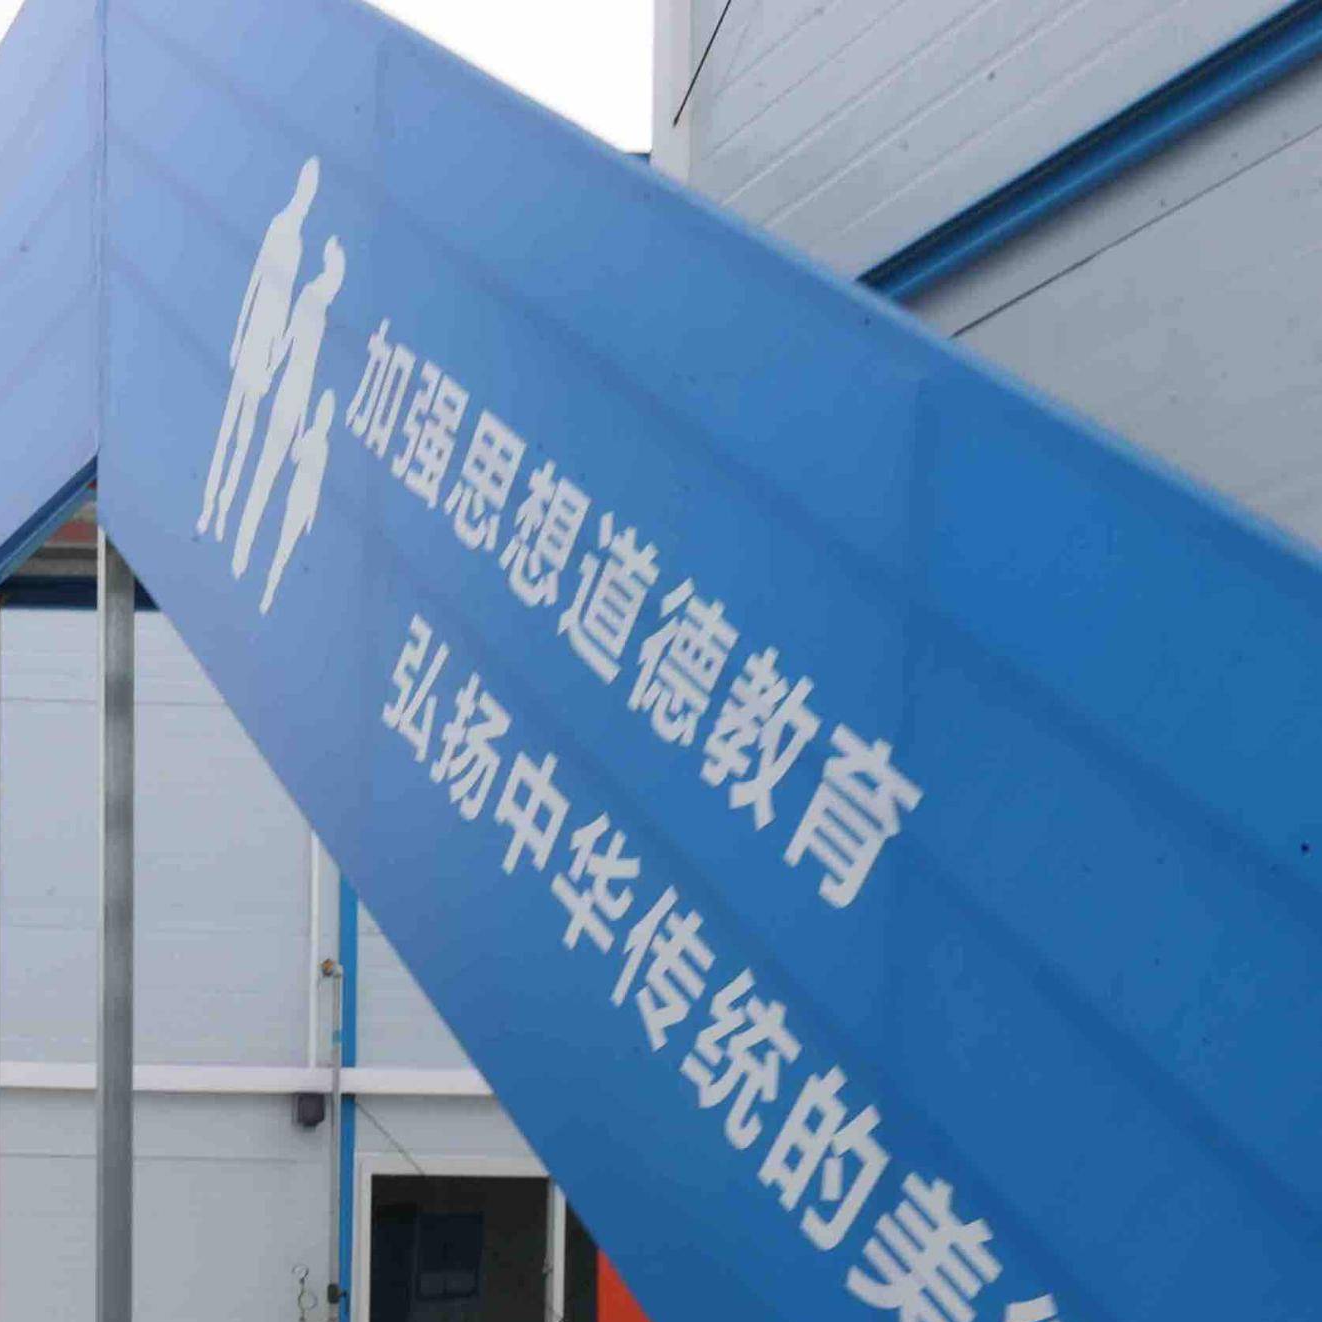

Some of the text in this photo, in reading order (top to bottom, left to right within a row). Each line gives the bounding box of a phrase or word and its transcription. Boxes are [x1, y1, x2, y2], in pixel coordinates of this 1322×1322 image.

[344, 319, 925, 907] 加强思想道德教育
